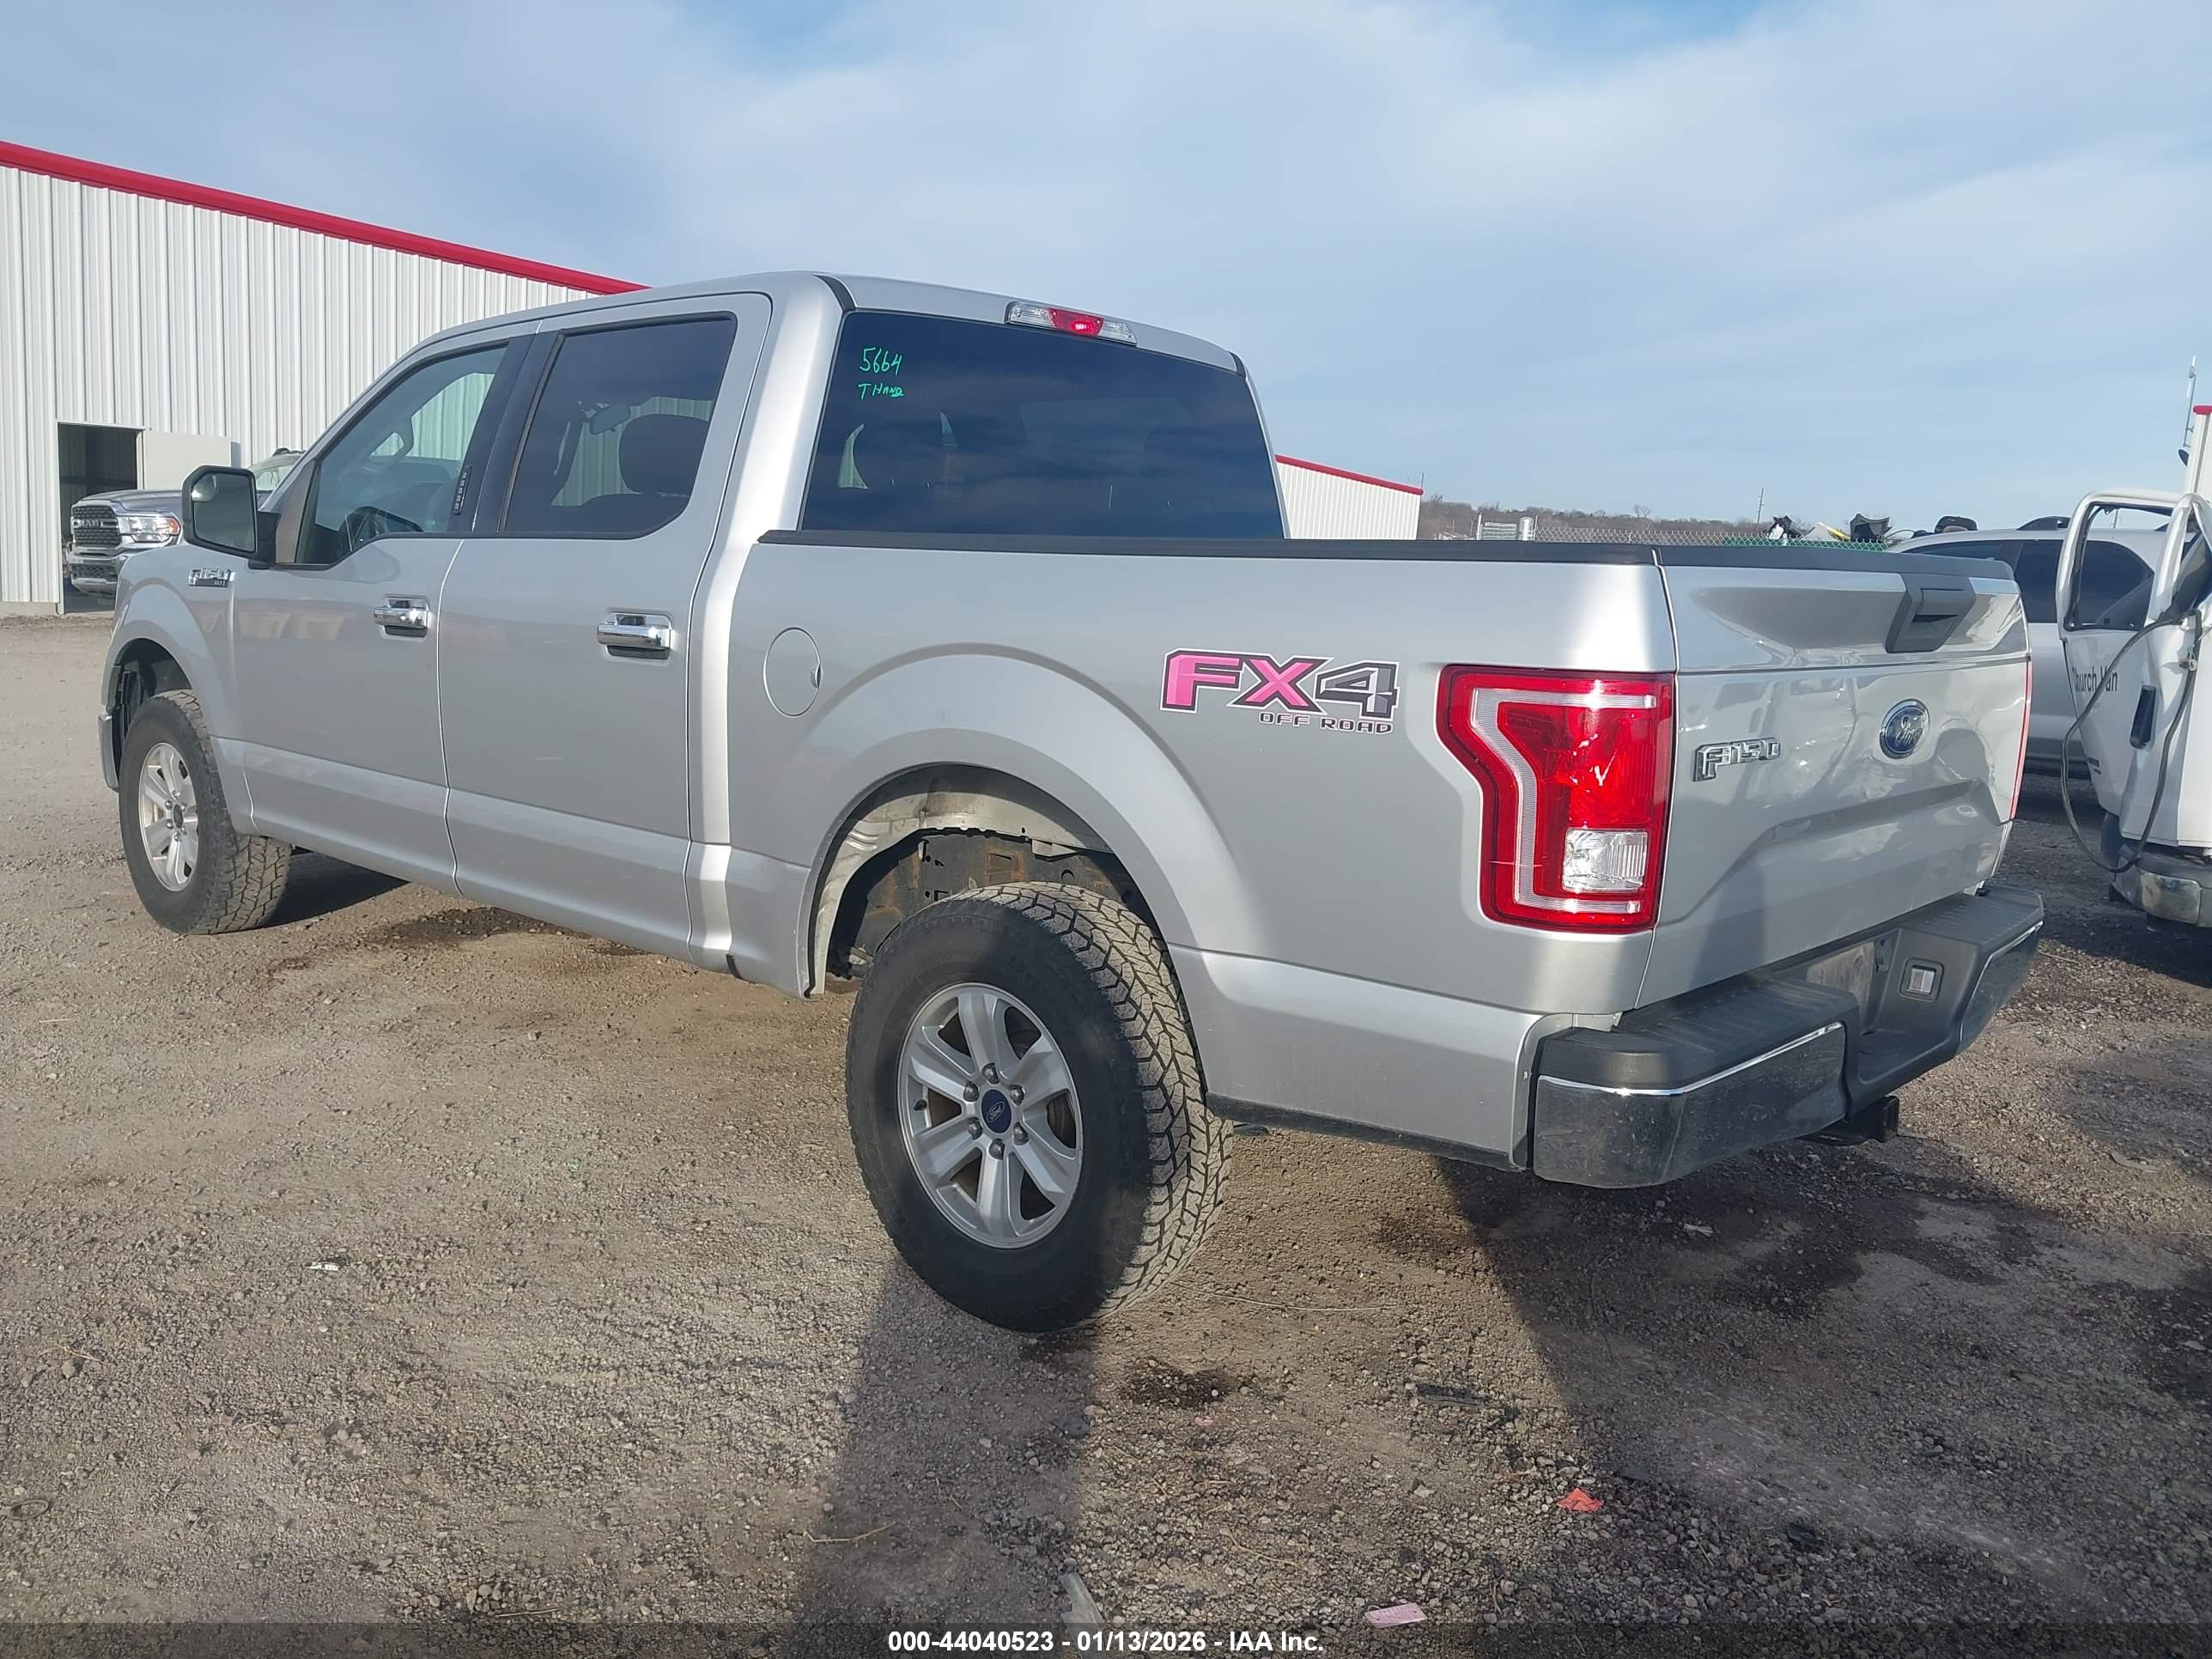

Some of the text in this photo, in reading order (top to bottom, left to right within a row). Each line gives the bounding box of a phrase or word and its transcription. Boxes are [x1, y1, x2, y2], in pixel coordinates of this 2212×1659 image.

[859, 347, 902, 376] 5664
[1160, 648, 1400, 721] FX4
[1259, 712, 1394, 734] OFF ROAD
[988, 1105, 1002, 1121] Ford
